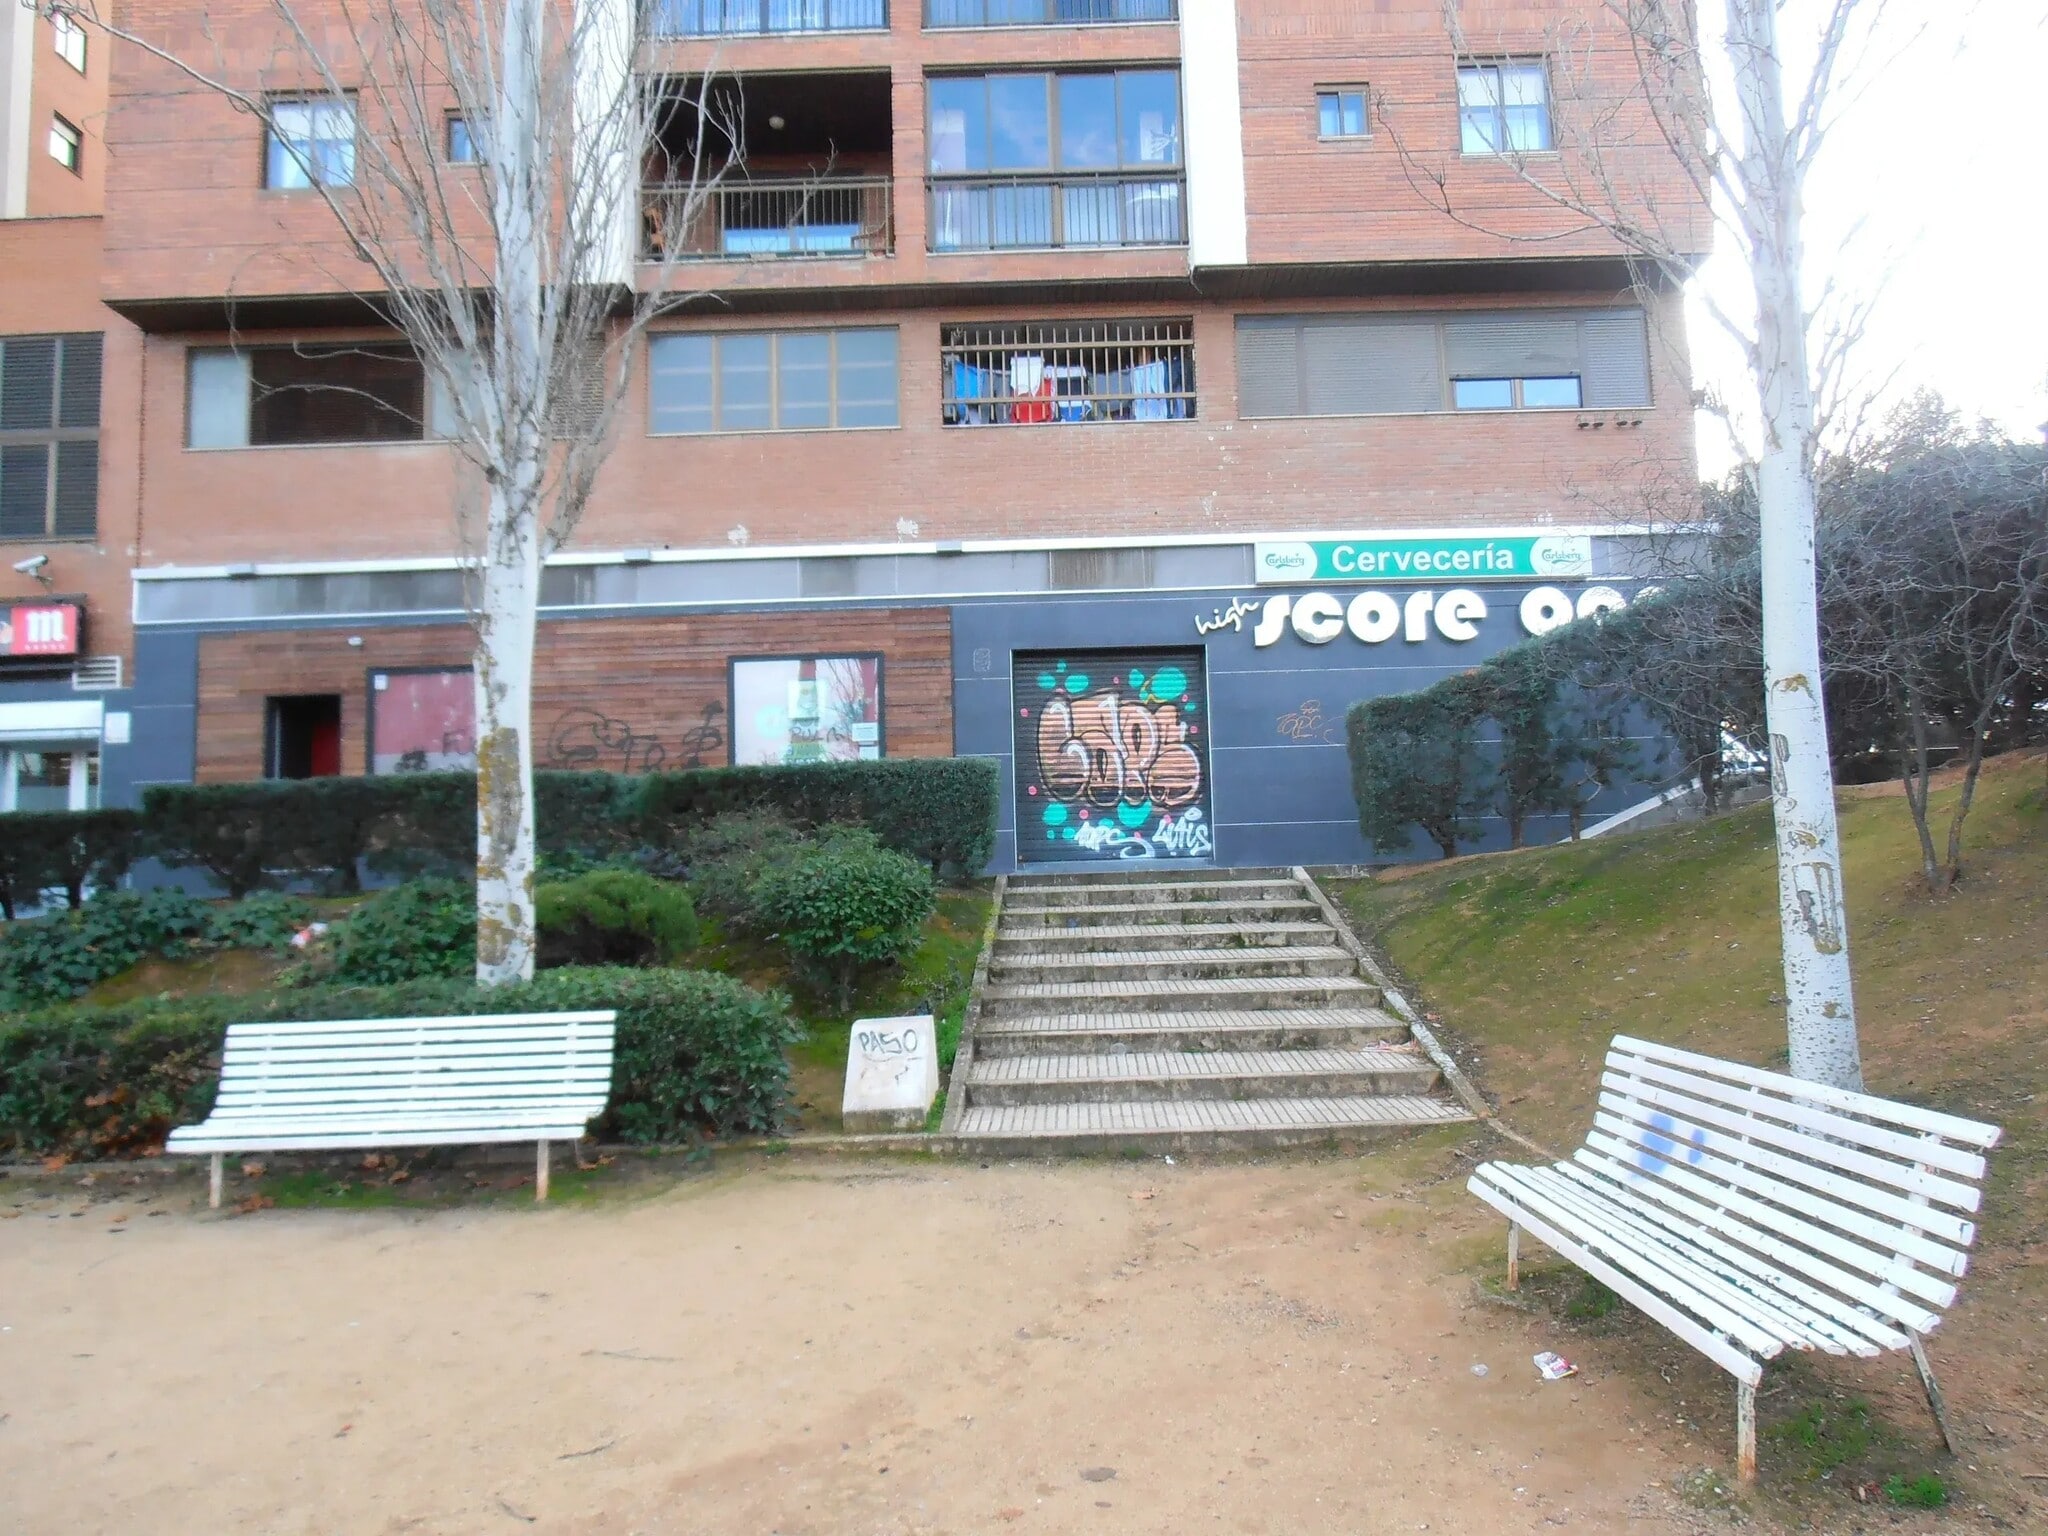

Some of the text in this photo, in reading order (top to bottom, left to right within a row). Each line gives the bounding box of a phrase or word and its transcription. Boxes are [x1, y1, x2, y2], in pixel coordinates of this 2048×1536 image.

[1265, 553, 1305, 569] Carlsberg
[1332, 542, 1514, 573] Cervecería
[1195, 597, 1259, 635] high
[1254, 589, 1487, 646] score
[859, 1029, 918, 1054] PASO
